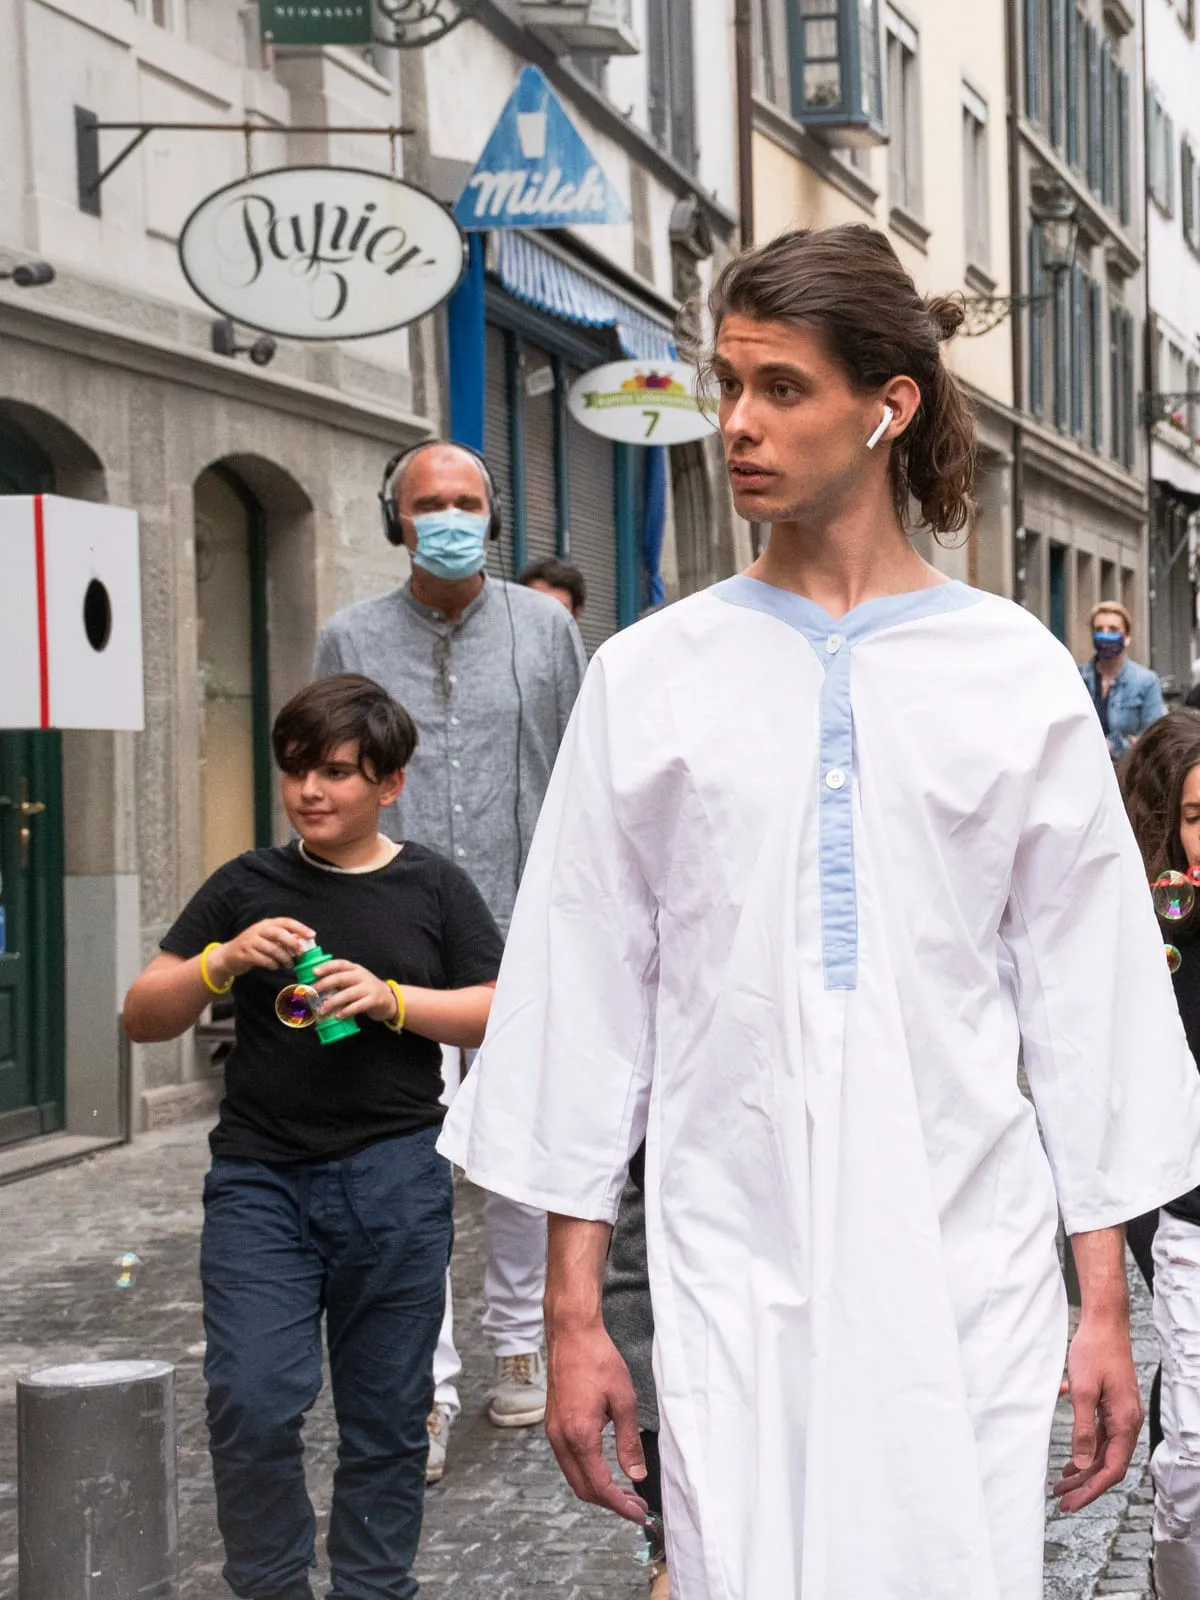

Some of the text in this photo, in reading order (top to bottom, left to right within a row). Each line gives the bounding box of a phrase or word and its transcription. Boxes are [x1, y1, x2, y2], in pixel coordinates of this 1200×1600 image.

[469, 165, 606, 217] Milch
[214, 194, 438, 322] Papier
[641, 410, 661, 439] 7
